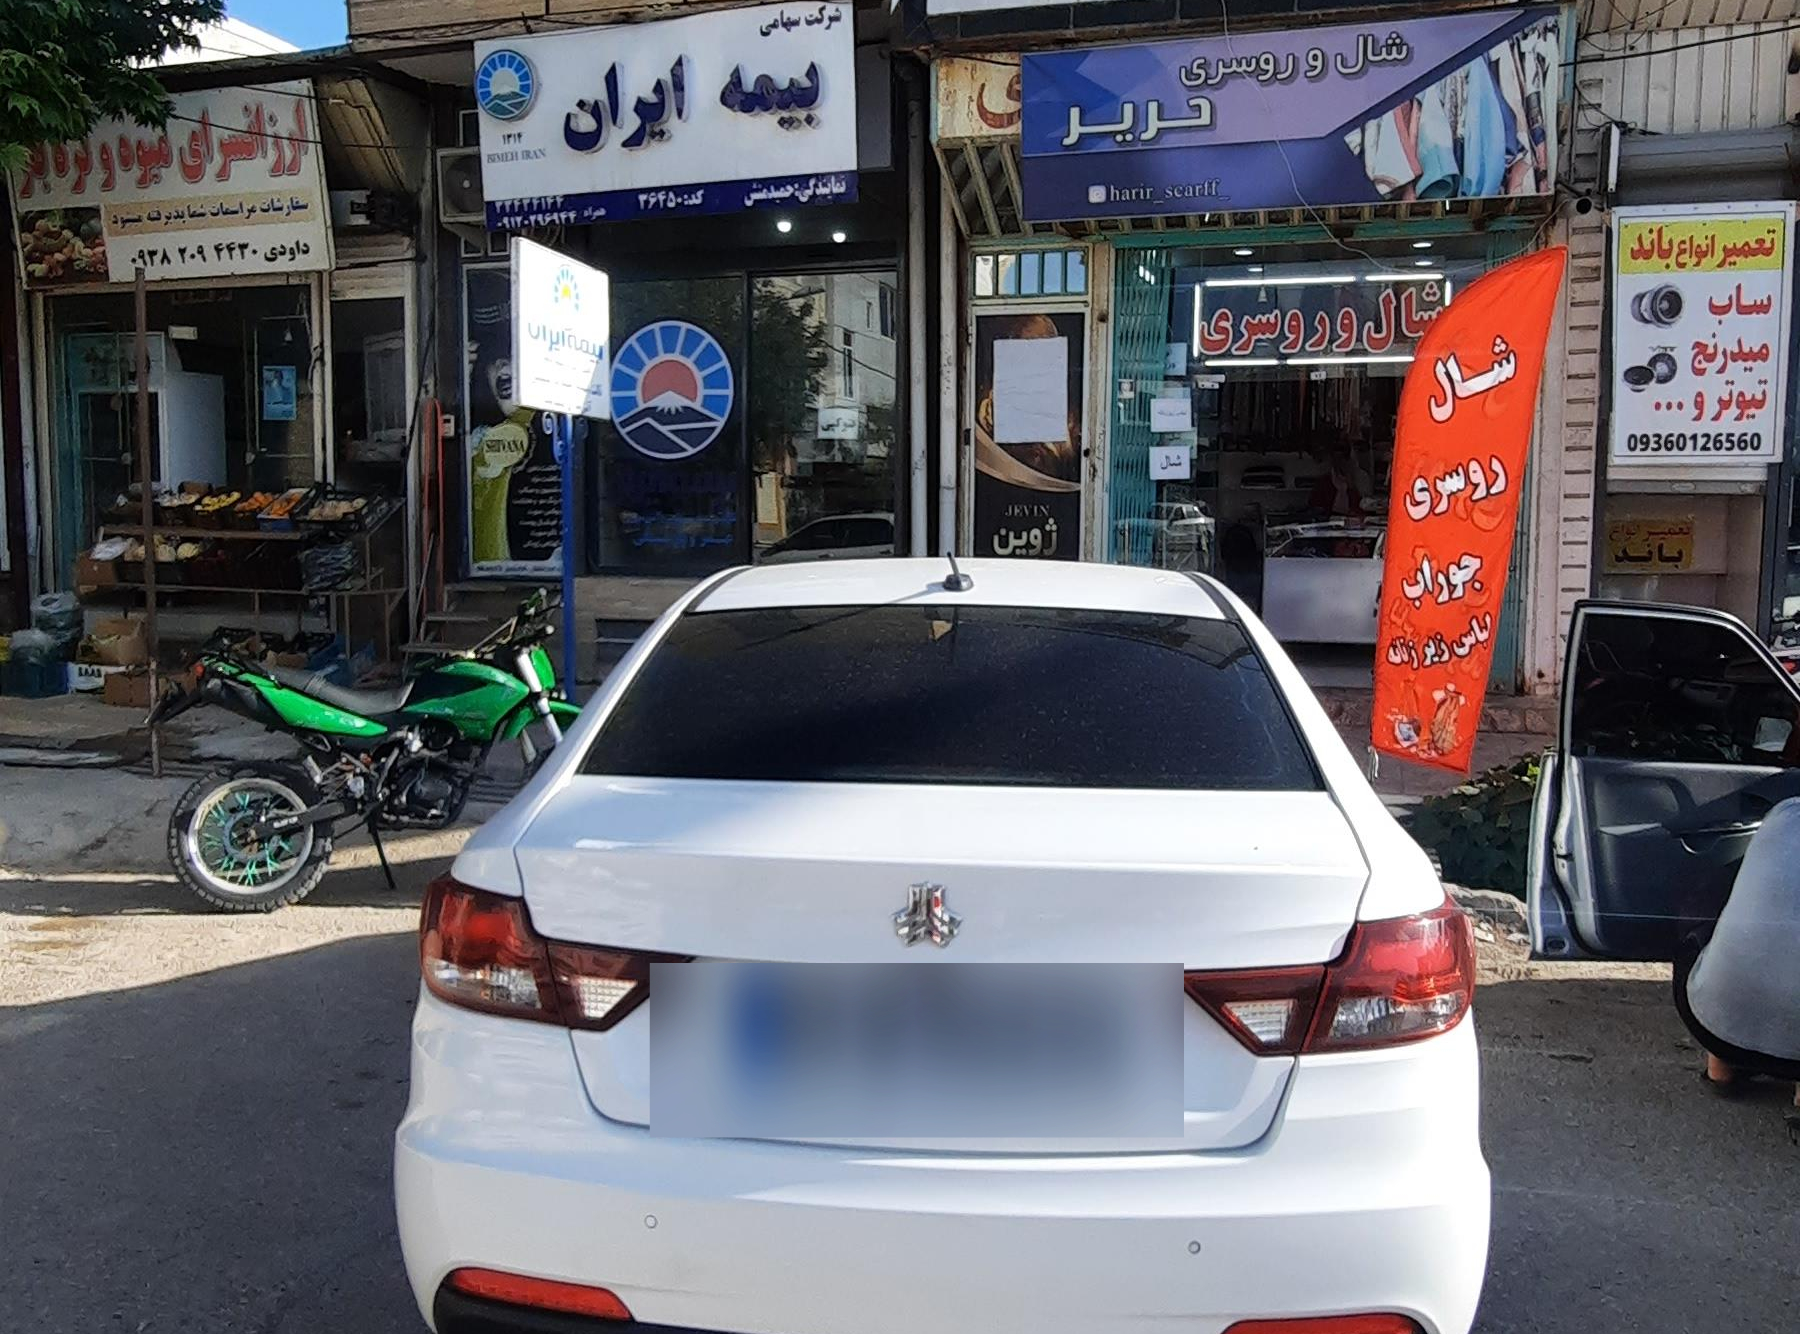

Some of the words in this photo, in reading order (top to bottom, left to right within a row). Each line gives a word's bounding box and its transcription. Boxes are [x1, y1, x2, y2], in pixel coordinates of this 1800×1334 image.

[760, 9, 801, 37] سهامی
[805, 5, 842, 30] شرکت
[1179, 46, 1297, 87] روسری
[1304, 45, 1327, 79] و
[1334, 31, 1411, 74] شال
[563, 53, 690, 154] ایران
[720, 60, 824, 130] بیمه
[1061, 93, 1215, 150] حریر
[99, 141, 116, 192] و
[119, 132, 173, 189] میوه
[487, 151, 518, 164] BIMEH
[521, 148, 547, 161] IRAN
[130, 247, 171, 267] ۰۹۳۸
[178, 244, 207, 264] ۲۰۹
[213, 242, 259, 262] ۴۴۳۰
[264, 239, 311, 262] داودی
[1631, 226, 1673, 269] باند
[1675, 233, 1716, 269] انواع
[1717, 228, 1777, 268] تعمیر
[1708, 283, 1772, 325] ساب
[1332, 307, 1357, 353] و
[1690, 331, 1770, 377] میدرنج
[1428, 335, 1518, 424] شال
[1691, 390, 1705, 422] و
[1711, 379, 1768, 422] تیوتر
[1627, 431, 1762, 452] 09360126560
[1160, 454, 1182, 470] شال
[1403, 454, 1509, 522] روسری
[1004, 504, 1051, 517] JEVIN
[991, 517, 1059, 556] ژوین
[1615, 543, 1684, 569] باند
[1401, 549, 1485, 610] جوراب
[1422, 632, 1452, 669] زیر
[1451, 611, 1492, 658] لباس
